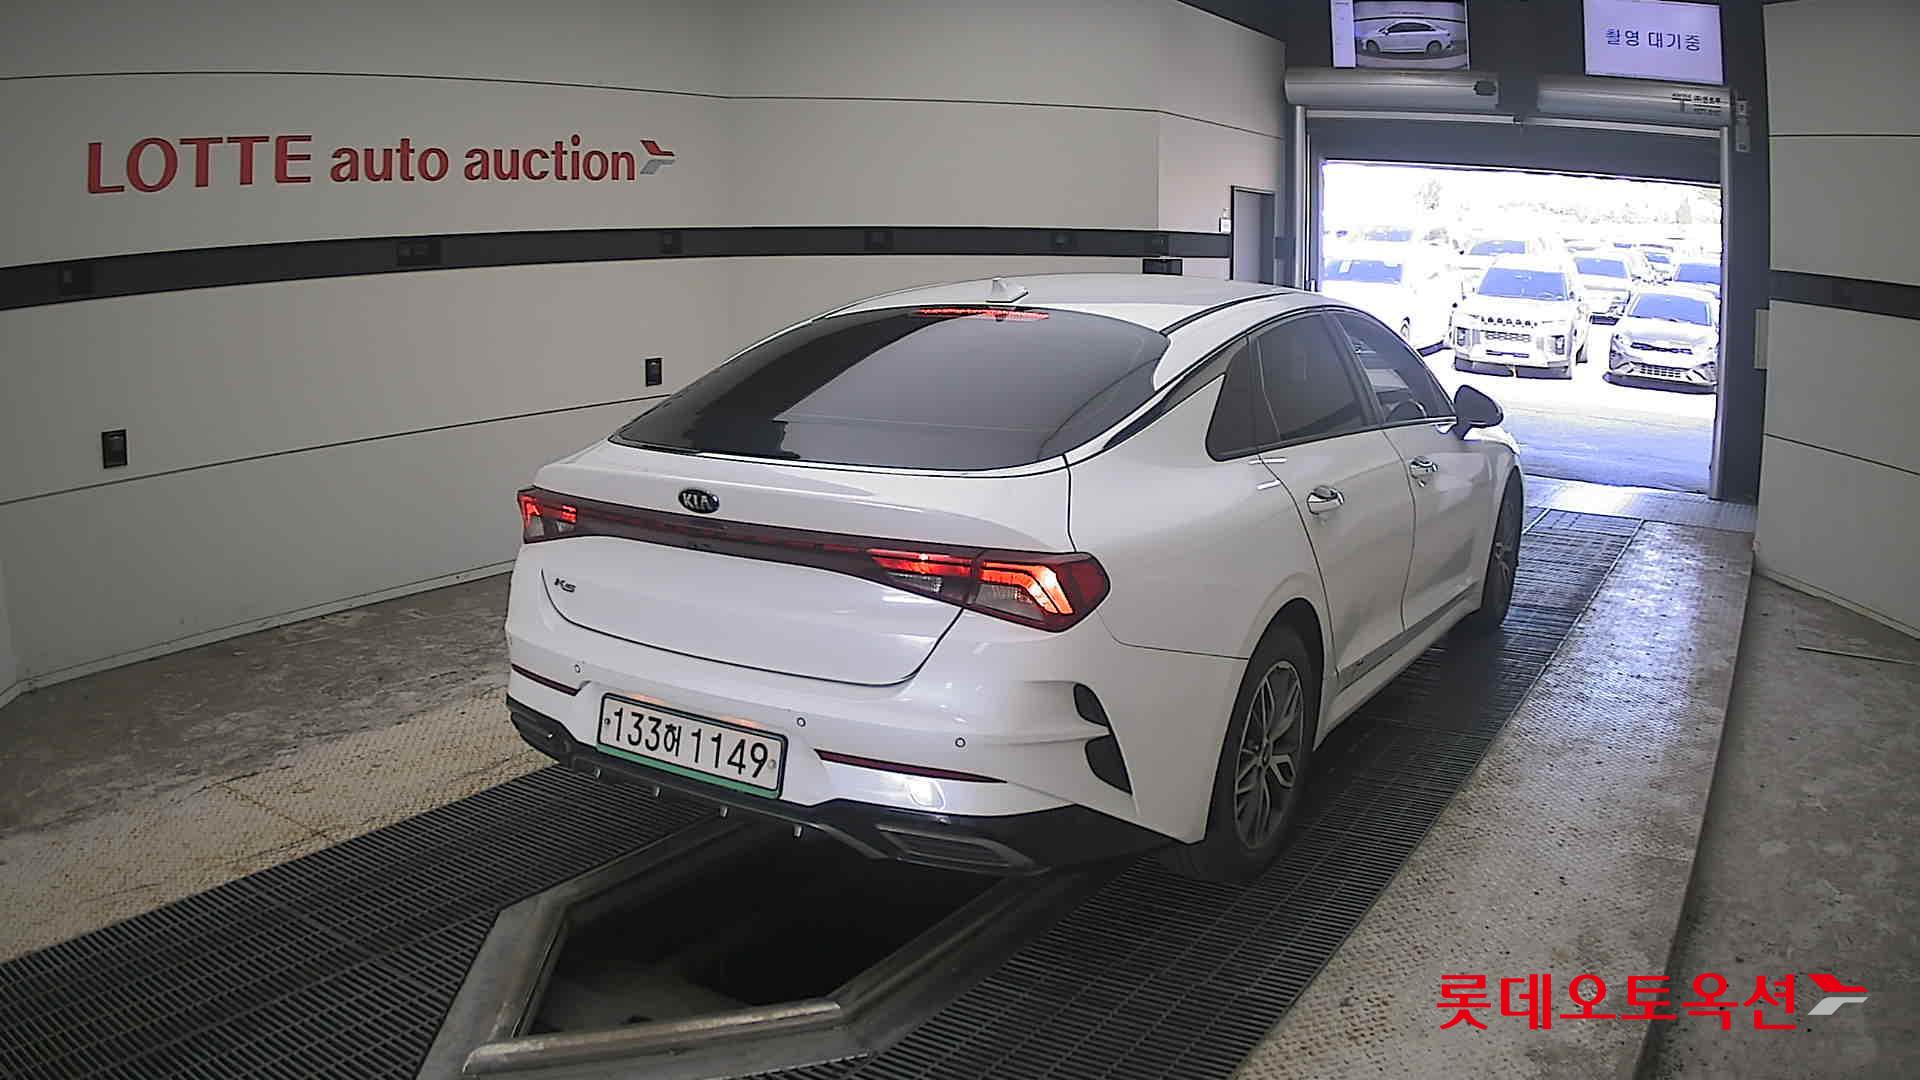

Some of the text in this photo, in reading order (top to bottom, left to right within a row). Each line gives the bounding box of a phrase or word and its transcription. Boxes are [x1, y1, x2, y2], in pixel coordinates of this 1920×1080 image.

[1606, 28, 1701, 52] 촬영 대기중
[87, 133, 636, 194] LOTTE auto auction
[682, 492, 713, 510] KIA
[554, 578, 577, 593] K5
[613, 707, 769, 779] 133허 1149
